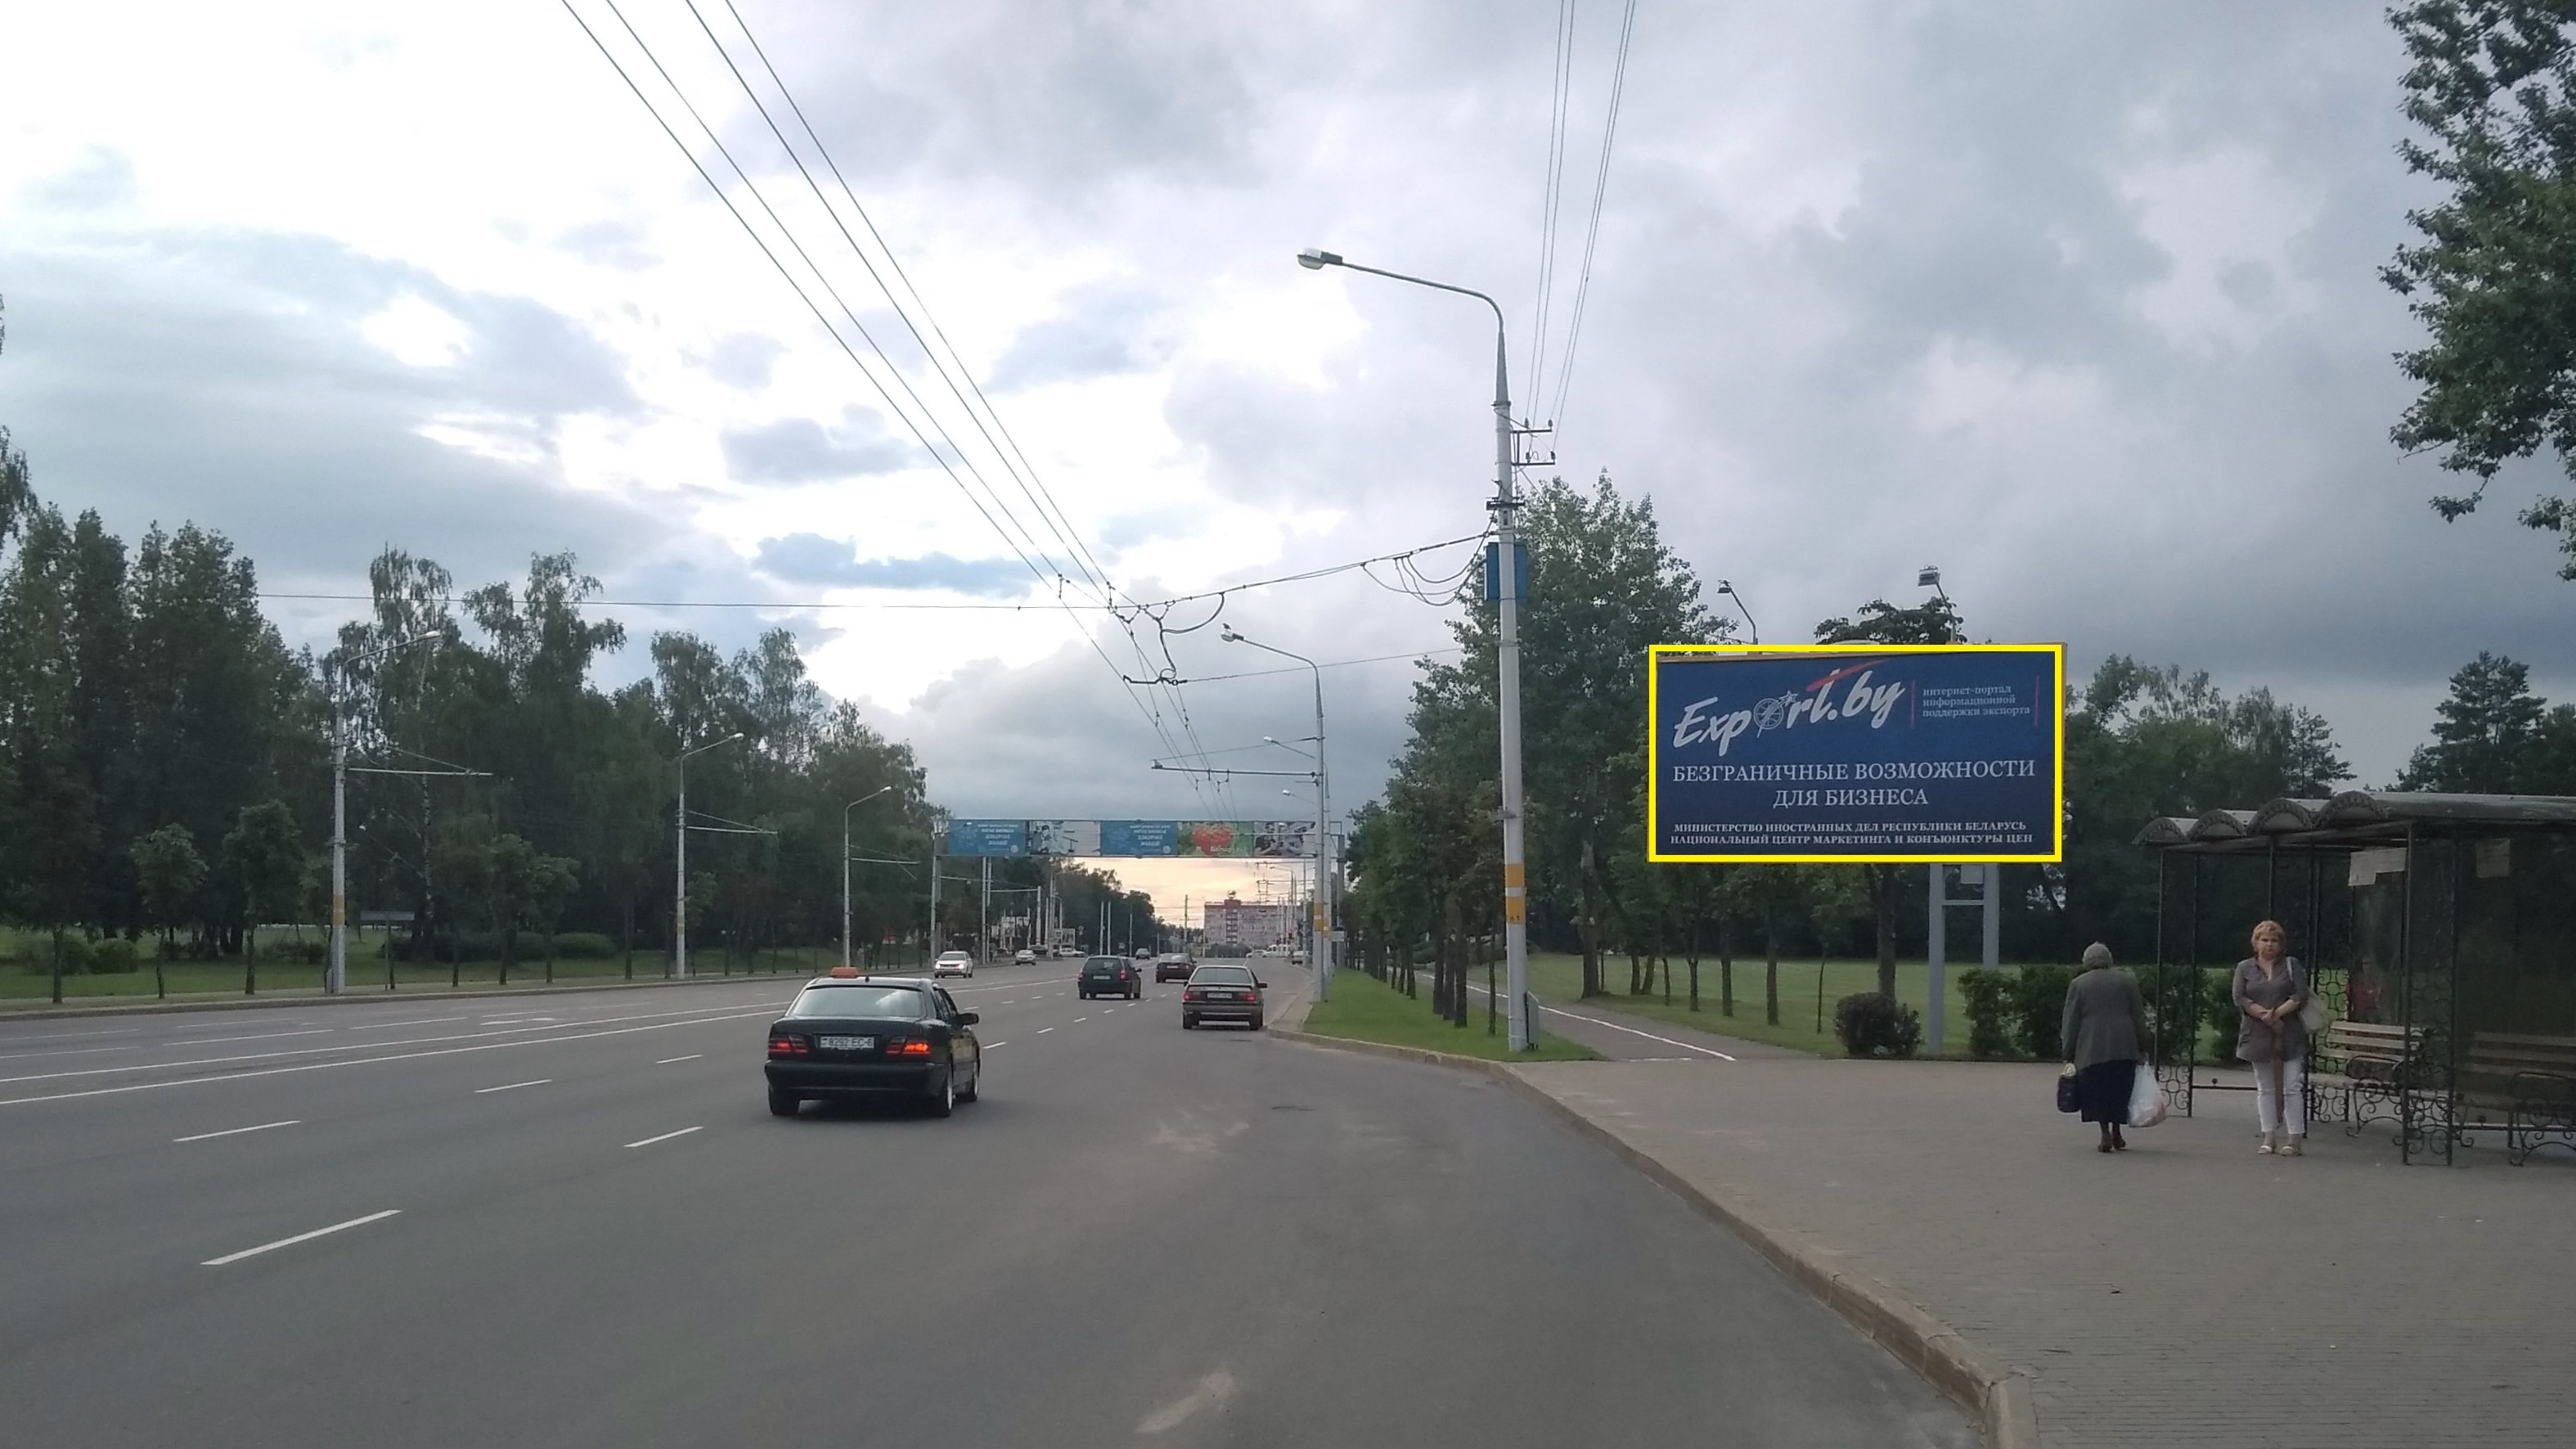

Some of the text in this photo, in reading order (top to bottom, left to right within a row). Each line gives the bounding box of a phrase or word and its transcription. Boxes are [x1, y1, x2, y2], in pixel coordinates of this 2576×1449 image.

[1922, 686, 2012, 697] интернет-портал
[1922, 695, 2016, 708] информационной
[1922, 706, 2030, 718] поддержки экспорта
[1672, 760, 2036, 783] БЕЗГРАНИЧНЫЕ ВОЗМОЖНОСТИ
[1773, 788, 1929, 809] ДЛЯ БИЗНЕСА
[1674, 821, 2027, 833] МИНИСТЕРСТВО ИНОСТРАННЫХ ДЕЛ РЕСПУБЛИКИ БЕЛАРУСЬ
[1670, 834, 2034, 845] НАЦИОНАЛЬНЫЙ ЦЕНТР МАРКЕТИНГА И КОНЪЮНКТУРЫ ЦЕН
